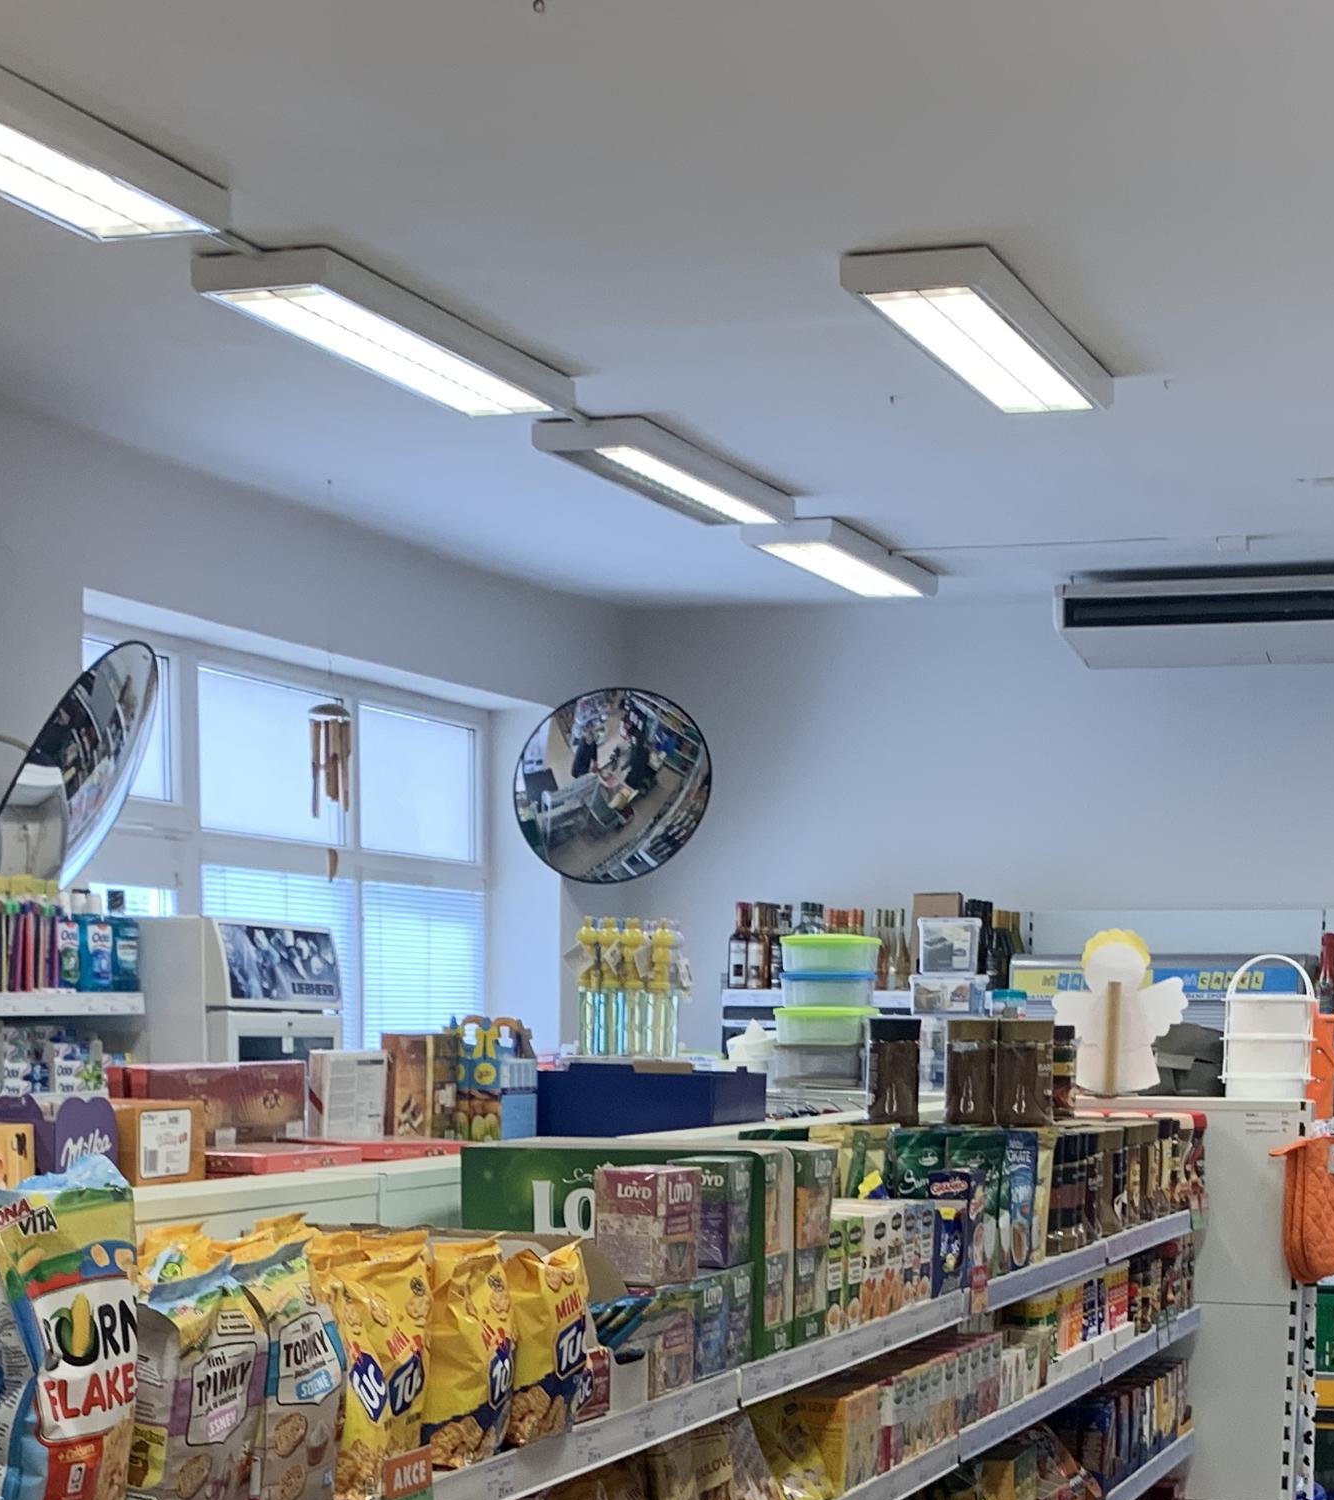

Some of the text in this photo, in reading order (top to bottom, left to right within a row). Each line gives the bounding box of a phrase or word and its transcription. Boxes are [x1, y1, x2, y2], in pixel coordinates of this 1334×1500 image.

[292, 982, 335, 997] LIEBHERR
[617, 1181, 652, 1200] LOYD
[667, 1177, 693, 1204] LOYD
[930, 1179, 968, 1196] GRANKO
[18, 1205, 58, 1236] VITA
[553, 1292, 583, 1322] MINI
[392, 1459, 427, 1492] AKCE
